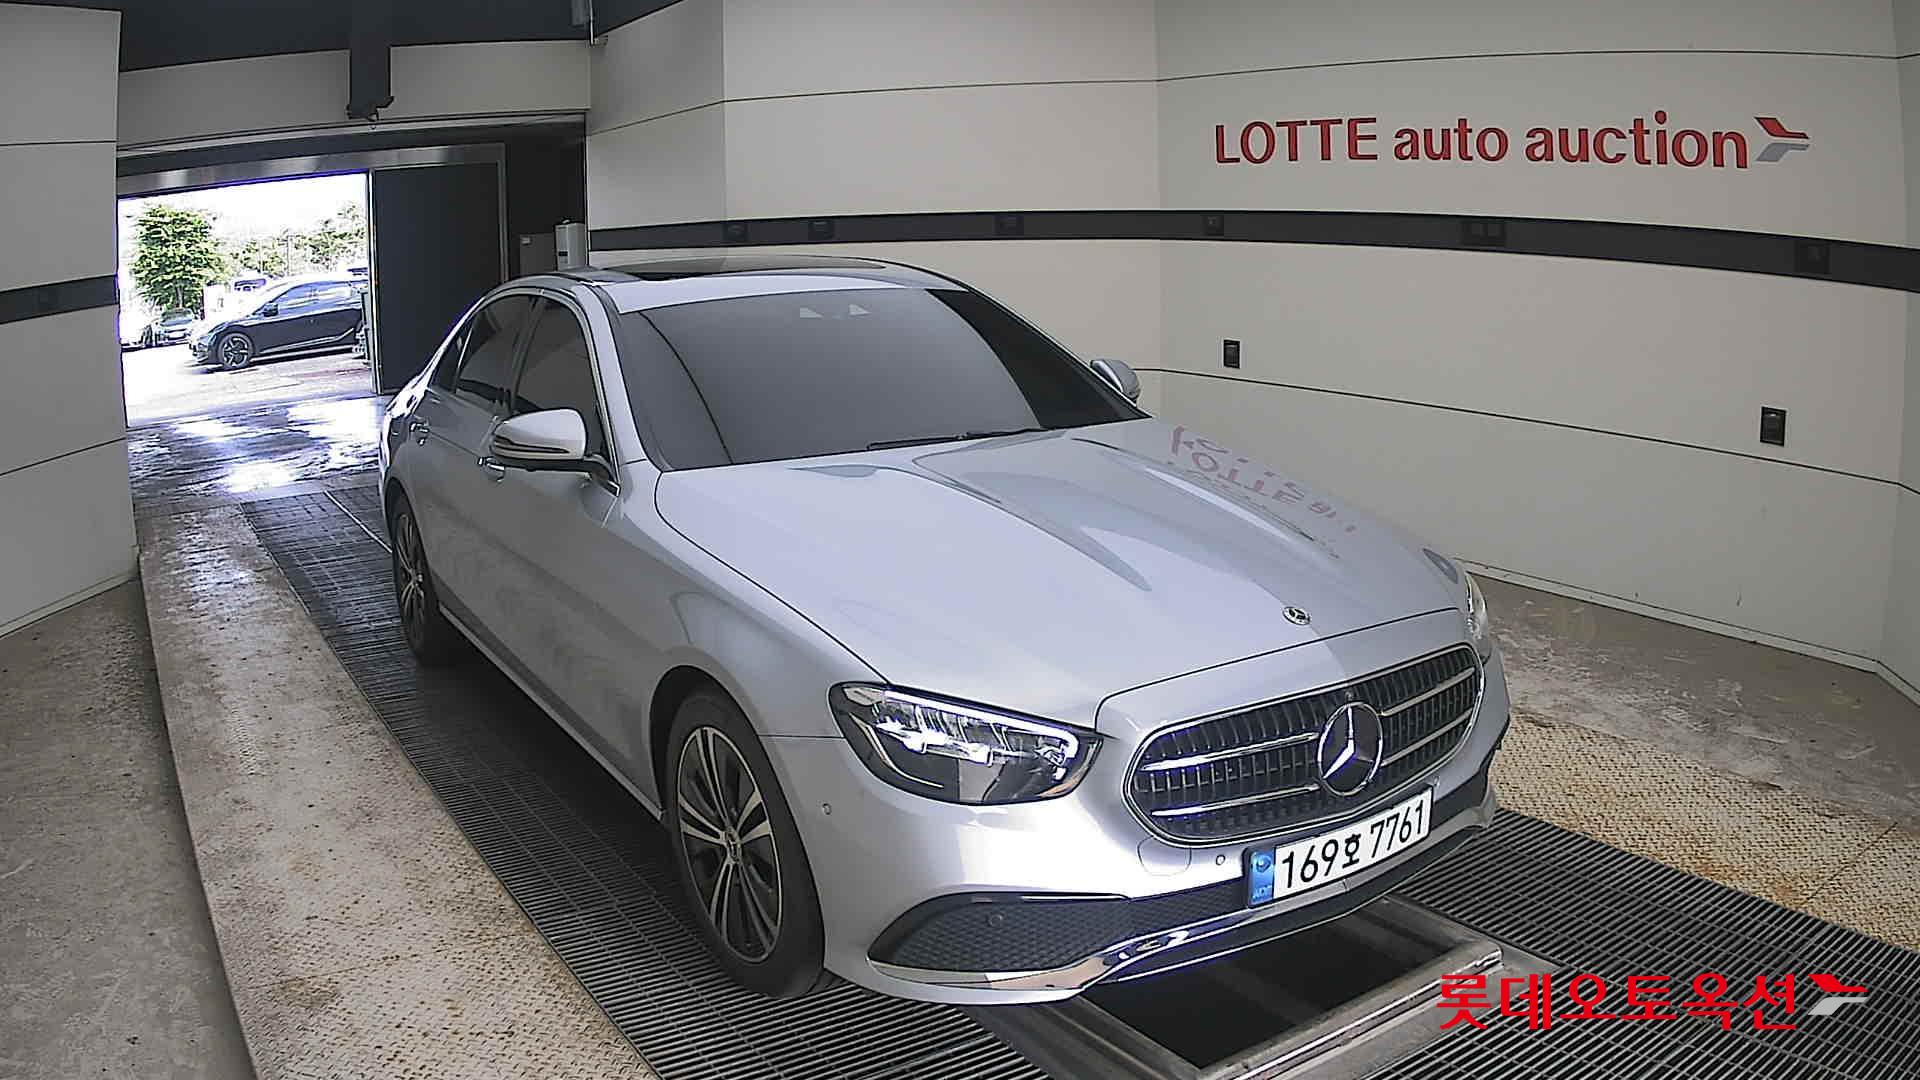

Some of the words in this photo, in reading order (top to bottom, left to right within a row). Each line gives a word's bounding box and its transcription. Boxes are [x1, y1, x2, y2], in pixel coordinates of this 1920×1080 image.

[1215, 117, 1378, 164] LOTTE
[1393, 118, 1509, 162] auto
[1525, 110, 1749, 169] auction
[1281, 833, 1361, 888] 169호
[1370, 799, 1424, 859] 7761
